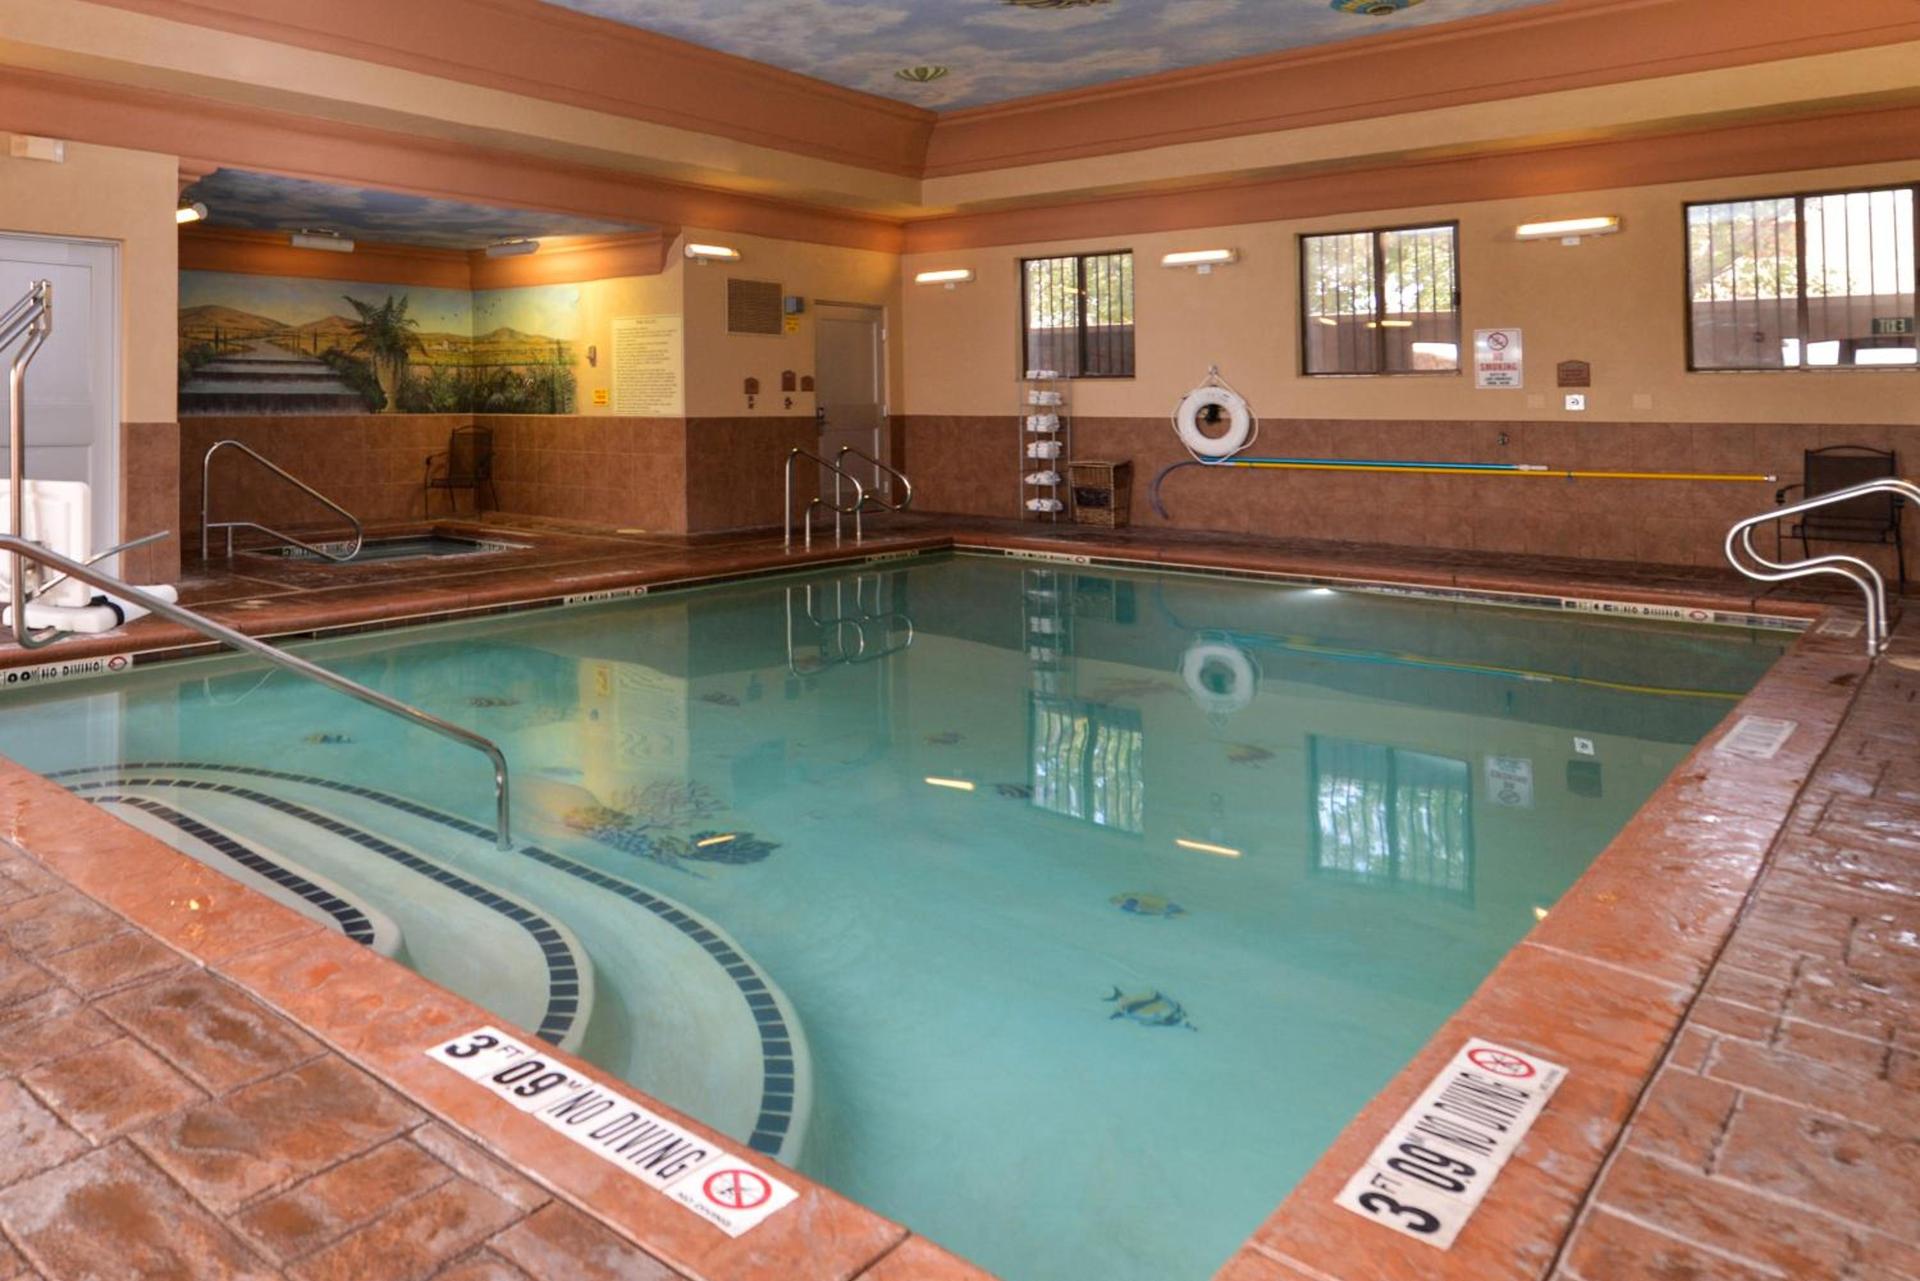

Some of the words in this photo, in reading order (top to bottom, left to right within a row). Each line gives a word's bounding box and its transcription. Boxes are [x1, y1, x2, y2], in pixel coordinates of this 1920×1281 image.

[42, 667, 57, 679] NO
[1434, 1072, 1530, 1132] DIVING
[547, 1090, 615, 1126] NO
[588, 1112, 706, 1180] DIVING
[1415, 1115, 1498, 1158] NO
